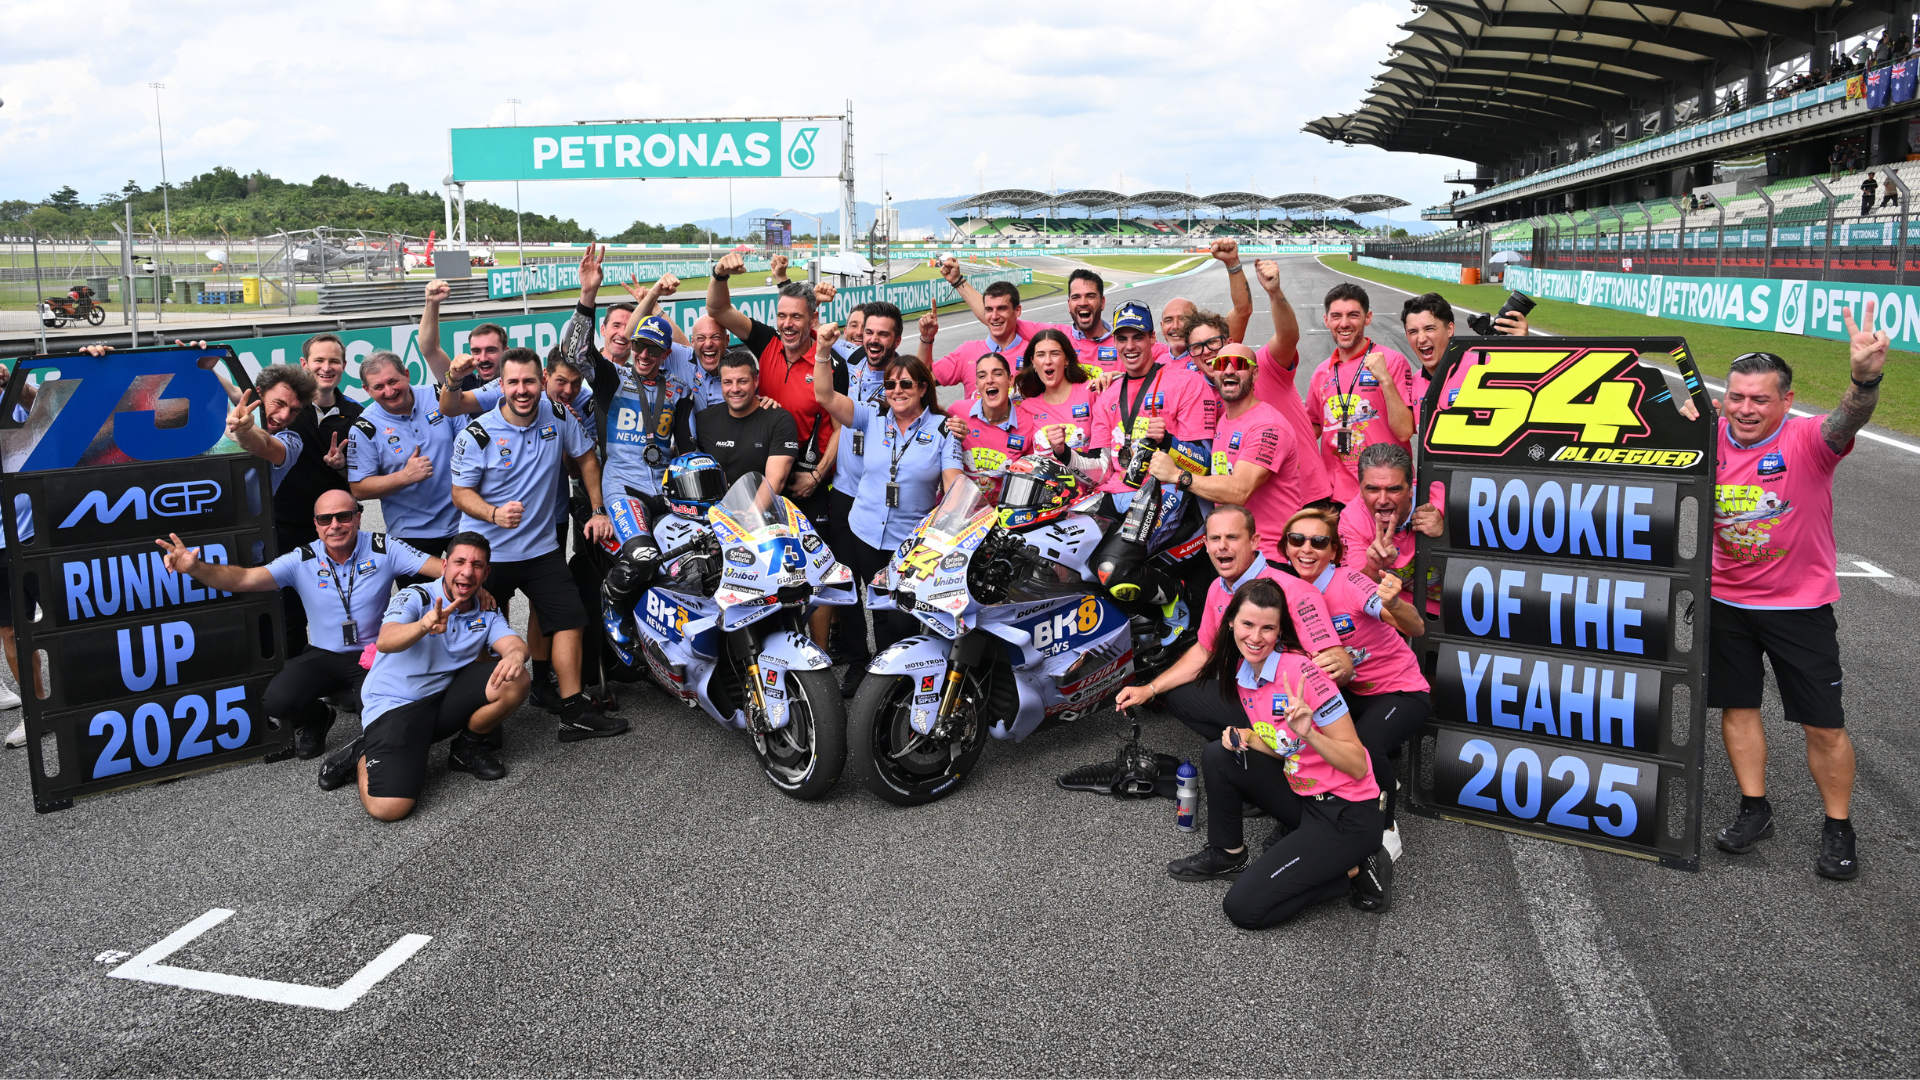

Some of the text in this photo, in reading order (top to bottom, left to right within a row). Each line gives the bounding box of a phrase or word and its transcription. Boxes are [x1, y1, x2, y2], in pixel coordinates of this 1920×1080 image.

[1799, 93, 1817, 105] PETRONAS
[1827, 85, 1845, 97] PETRONAS
[533, 132, 771, 169] PETRONAS
[1781, 231, 1800, 241] PETRONAS
[1814, 231, 1837, 240] PETRAS
[1853, 229, 1878, 239] PETRONAS
[1239, 245, 1271, 253] PETRONAS
[1278, 245, 1312, 253] PETRONAS
[603, 263, 633, 283] PETRONAS
[638, 263, 663, 280] PETRONAS
[493, 270, 548, 295] PETRONAS
[1592, 275, 1648, 309] PETRONAS
[819, 287, 873, 325] ETRONAS
[886, 283, 930, 312] PETRONAS
[1662, 281, 1771, 324] PETRONAS
[1811, 288, 1920, 343] PETRON
[1431, 351, 1642, 447] 54
[616, 432, 647, 444] NEWS
[971, 446, 1008, 465] FEER
[975, 458, 1001, 470] MIN
[1175, 454, 1203, 474] Antangin
[1558, 446, 1696, 467] ALDEGUER
[1762, 475, 1784, 484] DUCATI
[671, 503, 698, 515] Red Bull
[1159, 493, 1178, 521] NEWS
[1718, 499, 1758, 513] MIN
[617, 516, 633, 538] NEWS
[712, 508, 746, 538] Antangin
[955, 513, 994, 543] Antangin
[1139, 511, 1154, 542] PROSECCO
[1469, 477, 1654, 561] ROOKIE
[714, 523, 736, 543] BK8
[962, 527, 986, 549] BK8
[729, 549, 752, 559] Estrella
[729, 555, 751, 564] Galicia
[757, 537, 808, 577] 73
[813, 551, 833, 569] Unibat
[944, 555, 965, 565] Estrella
[724, 567, 759, 582] Unibat
[933, 575, 965, 587] Unibat
[672, 593, 700, 610] DUCATI
[1017, 601, 1055, 620] DUCATI
[1461, 566, 1646, 655] OF THE
[646, 592, 690, 637] BK8
[1033, 597, 1100, 650] BK8
[645, 613, 668, 637] NEWS
[117, 620, 195, 692] UP
[1077, 660, 1119, 690] ASPIRA
[1104, 681, 1124, 697] OIL
[1457, 650, 1637, 748] YEAHH
[88, 686, 252, 779] 2025
[1457, 739, 1638, 837] 2025
